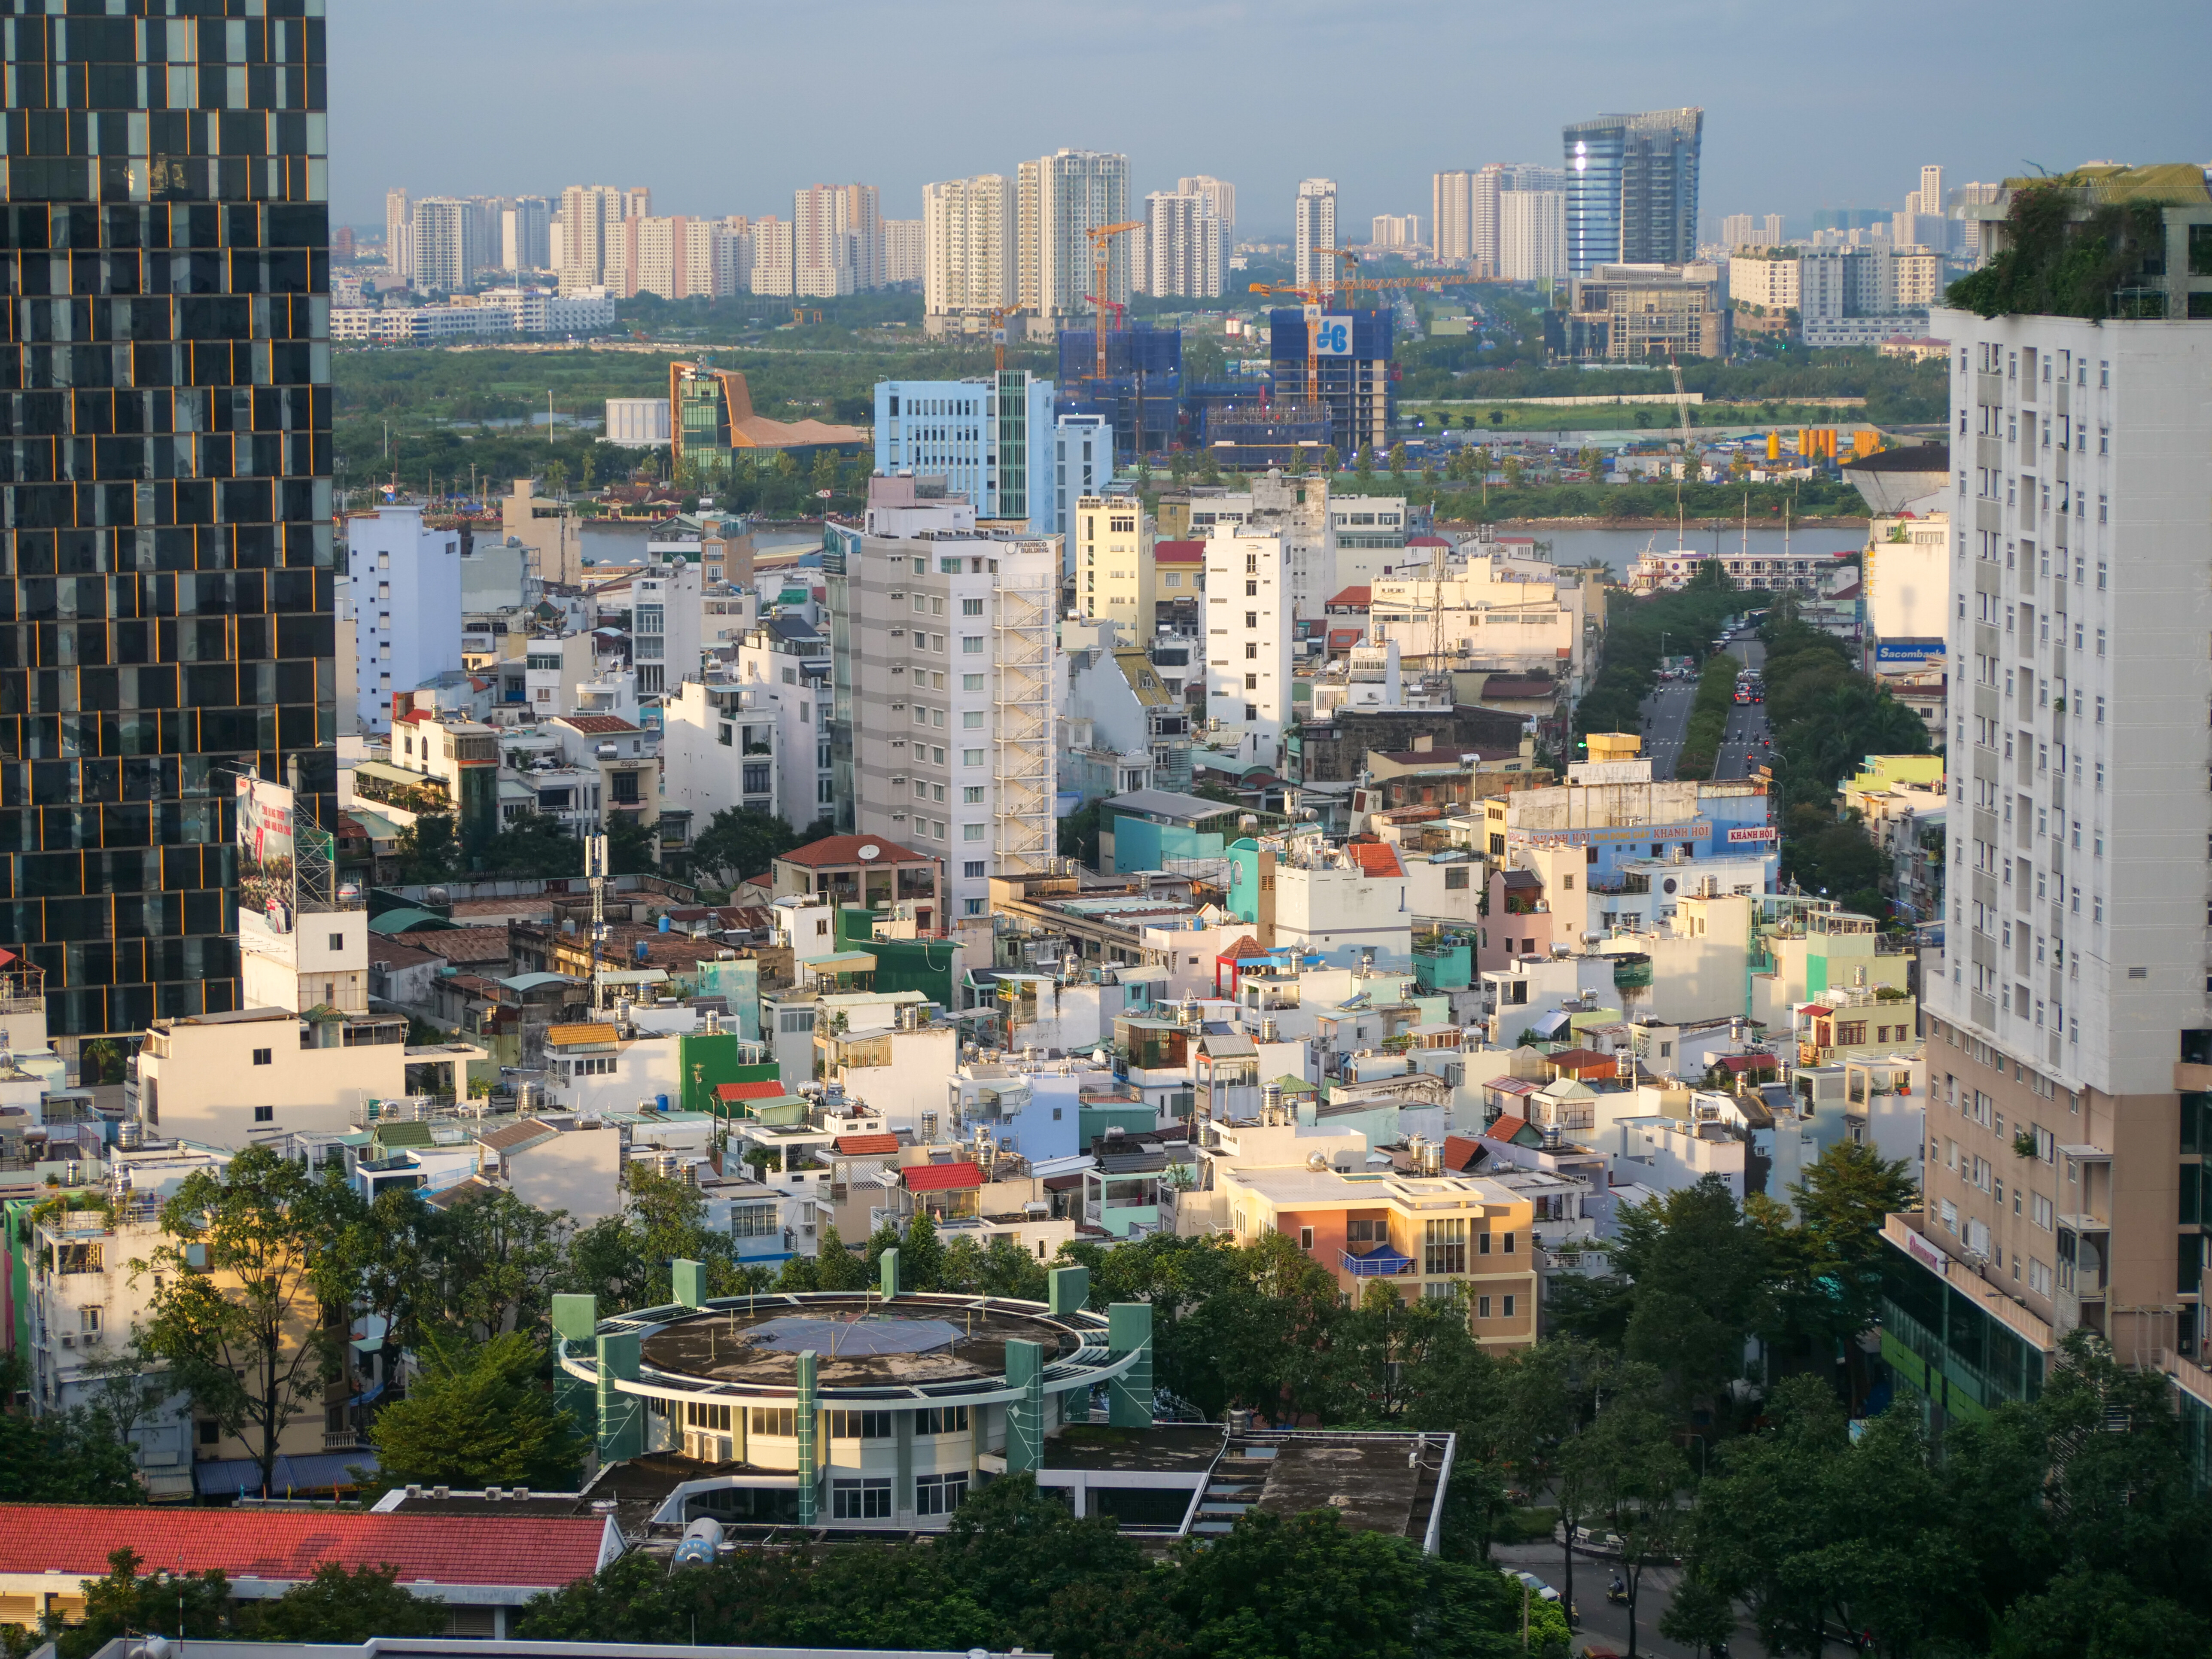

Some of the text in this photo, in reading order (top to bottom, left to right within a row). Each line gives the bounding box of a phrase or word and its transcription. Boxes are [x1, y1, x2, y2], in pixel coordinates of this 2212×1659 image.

[1880, 647, 1942, 658] Sacombank
[1654, 826, 1689, 838] KHÁNH
[1692, 825, 1709, 838] HỘI
[1731, 828, 1773, 840] KHÁNH HỘI
